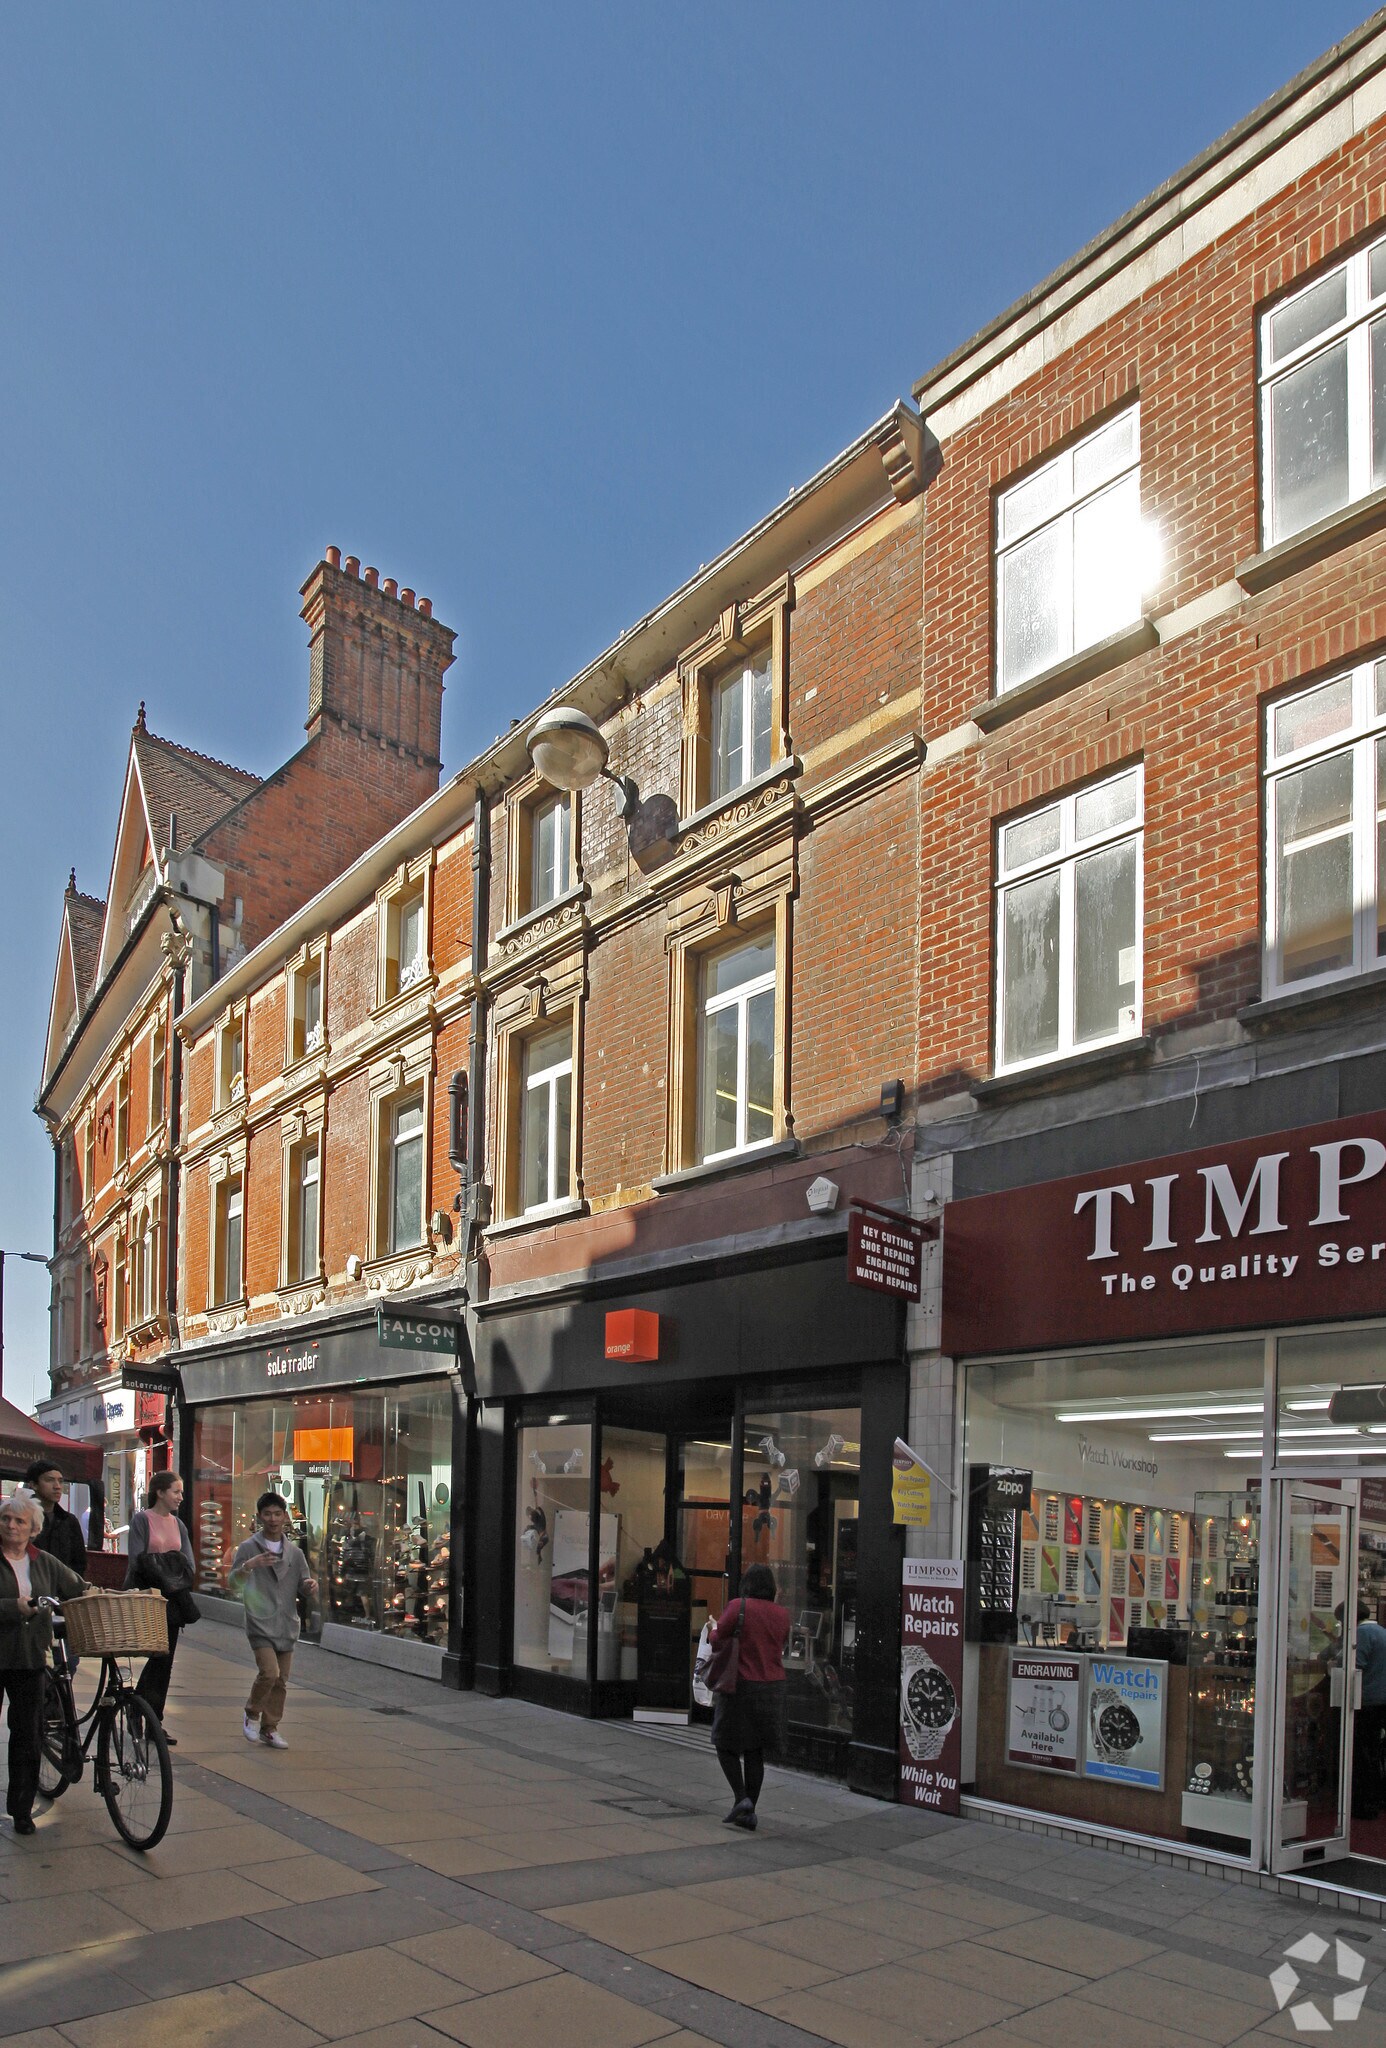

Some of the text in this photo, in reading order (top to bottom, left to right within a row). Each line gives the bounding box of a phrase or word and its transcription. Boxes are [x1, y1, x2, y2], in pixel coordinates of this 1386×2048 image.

[1074, 1137, 1386, 1261] TIMP
[863, 1225, 914, 1251] KEY CUTTING
[860, 1238, 915, 1266] SHOE REPAIRS
[866, 1254, 910, 1277] ENGRAVING
[1101, 1242, 1386, 1295] The Quality Ser
[856, 1266, 918, 1294] WATCH REPAIRS
[382, 1319, 455, 1338] FALCON
[383, 1333, 455, 1347] SPORT
[606, 1343, 631, 1354] orange
[1078, 1442, 1109, 1466] Watch
[1111, 1449, 1158, 1479] Workshop
[907, 1565, 959, 1576] TIMPSON
[909, 1593, 955, 1614] Watch
[904, 1614, 959, 1638] Repairs
[1018, 1664, 1073, 1678] ENGRAVING
[1092, 1663, 1158, 1689] Watch
[1121, 1688, 1158, 1701] Repairs
[1021, 1729, 1065, 1744] Available
[1031, 1741, 1053, 1753] Here
[901, 1765, 957, 1790] While You
[915, 1785, 942, 1805] Wait
